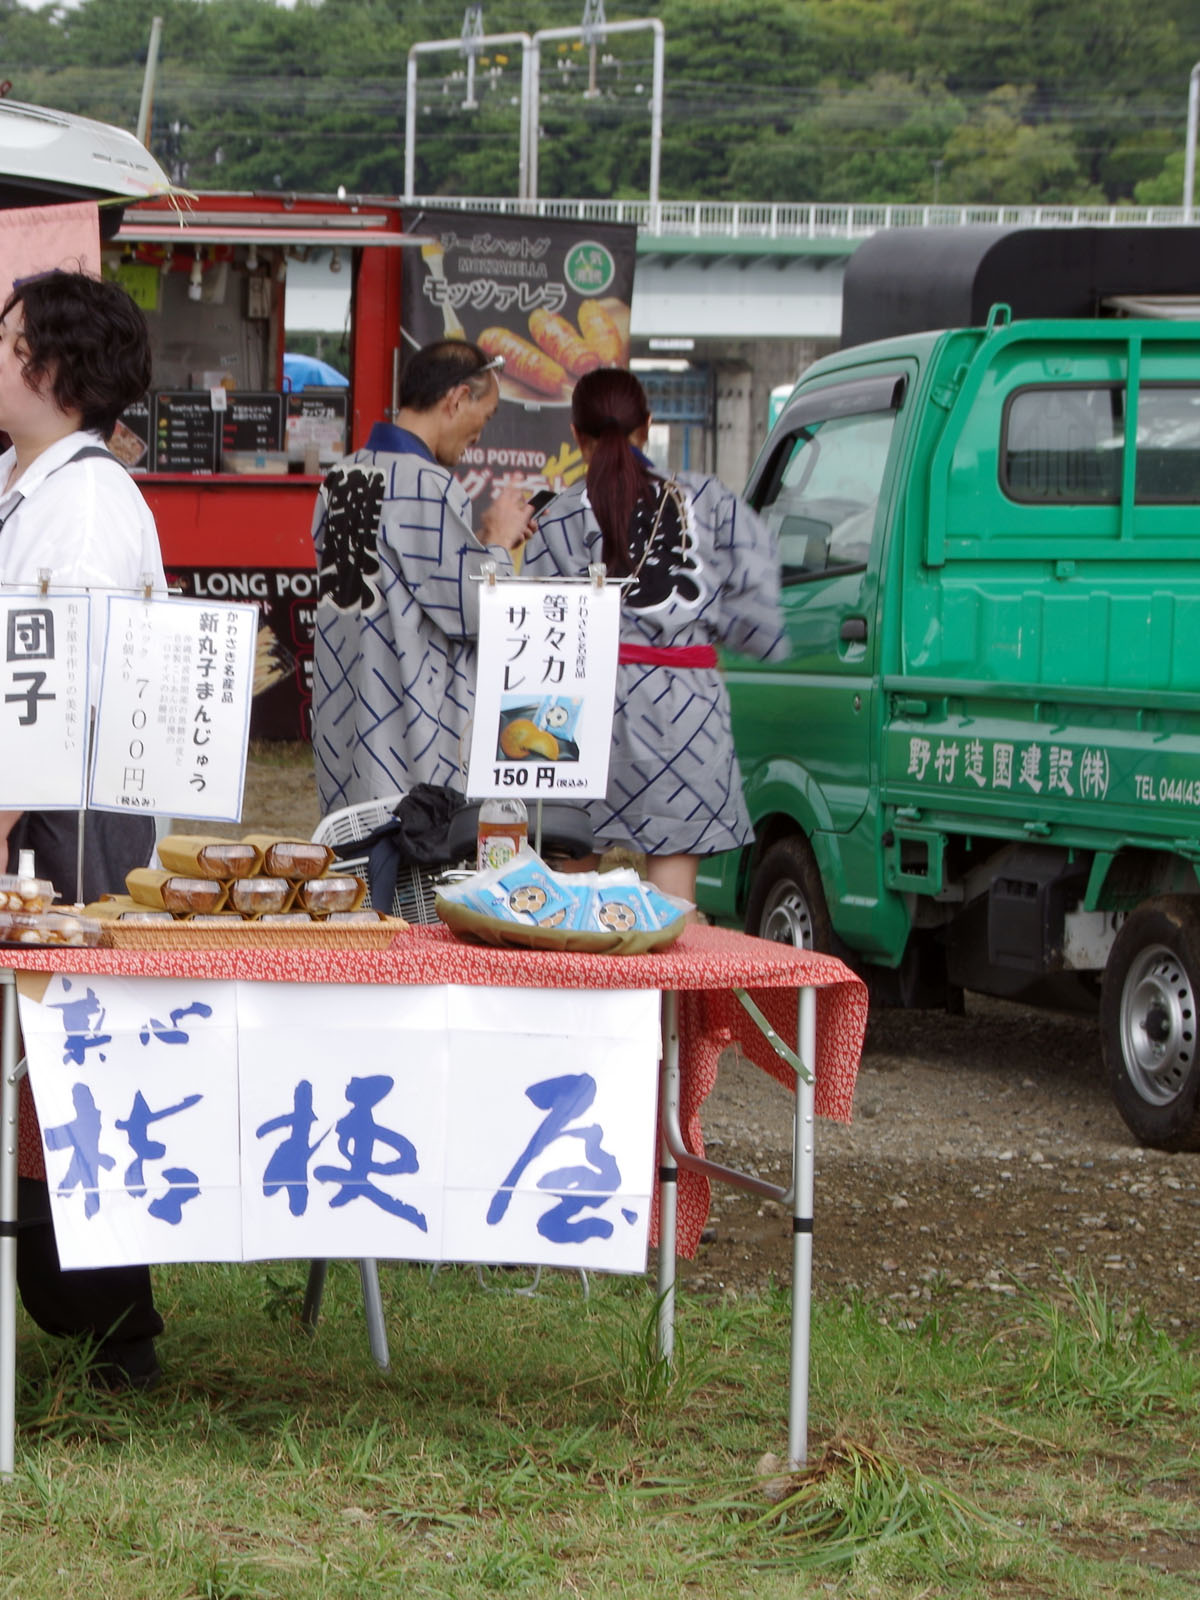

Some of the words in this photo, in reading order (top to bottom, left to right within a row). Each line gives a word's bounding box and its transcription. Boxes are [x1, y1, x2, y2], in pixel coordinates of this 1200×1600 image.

[423, 275, 568, 313] モッツァレラ
[458, 448, 484, 464] NG
[487, 448, 546, 467] POTATO
[193, 572, 268, 596] LONG
[4, 608, 56, 726] 団子
[221, 611, 239, 704] かわさき名産品
[503, 606, 530, 691] サブレ
[541, 594, 569, 684] 等々力
[123, 679, 149, 791] 700円
[189, 612, 219, 792] 新丸子まんじゅう
[907, 737, 1109, 800] 野村造園建設(株)
[1134, 775, 1157, 799] TEL
[44, 1072, 638, 1244] 桔梗屋
